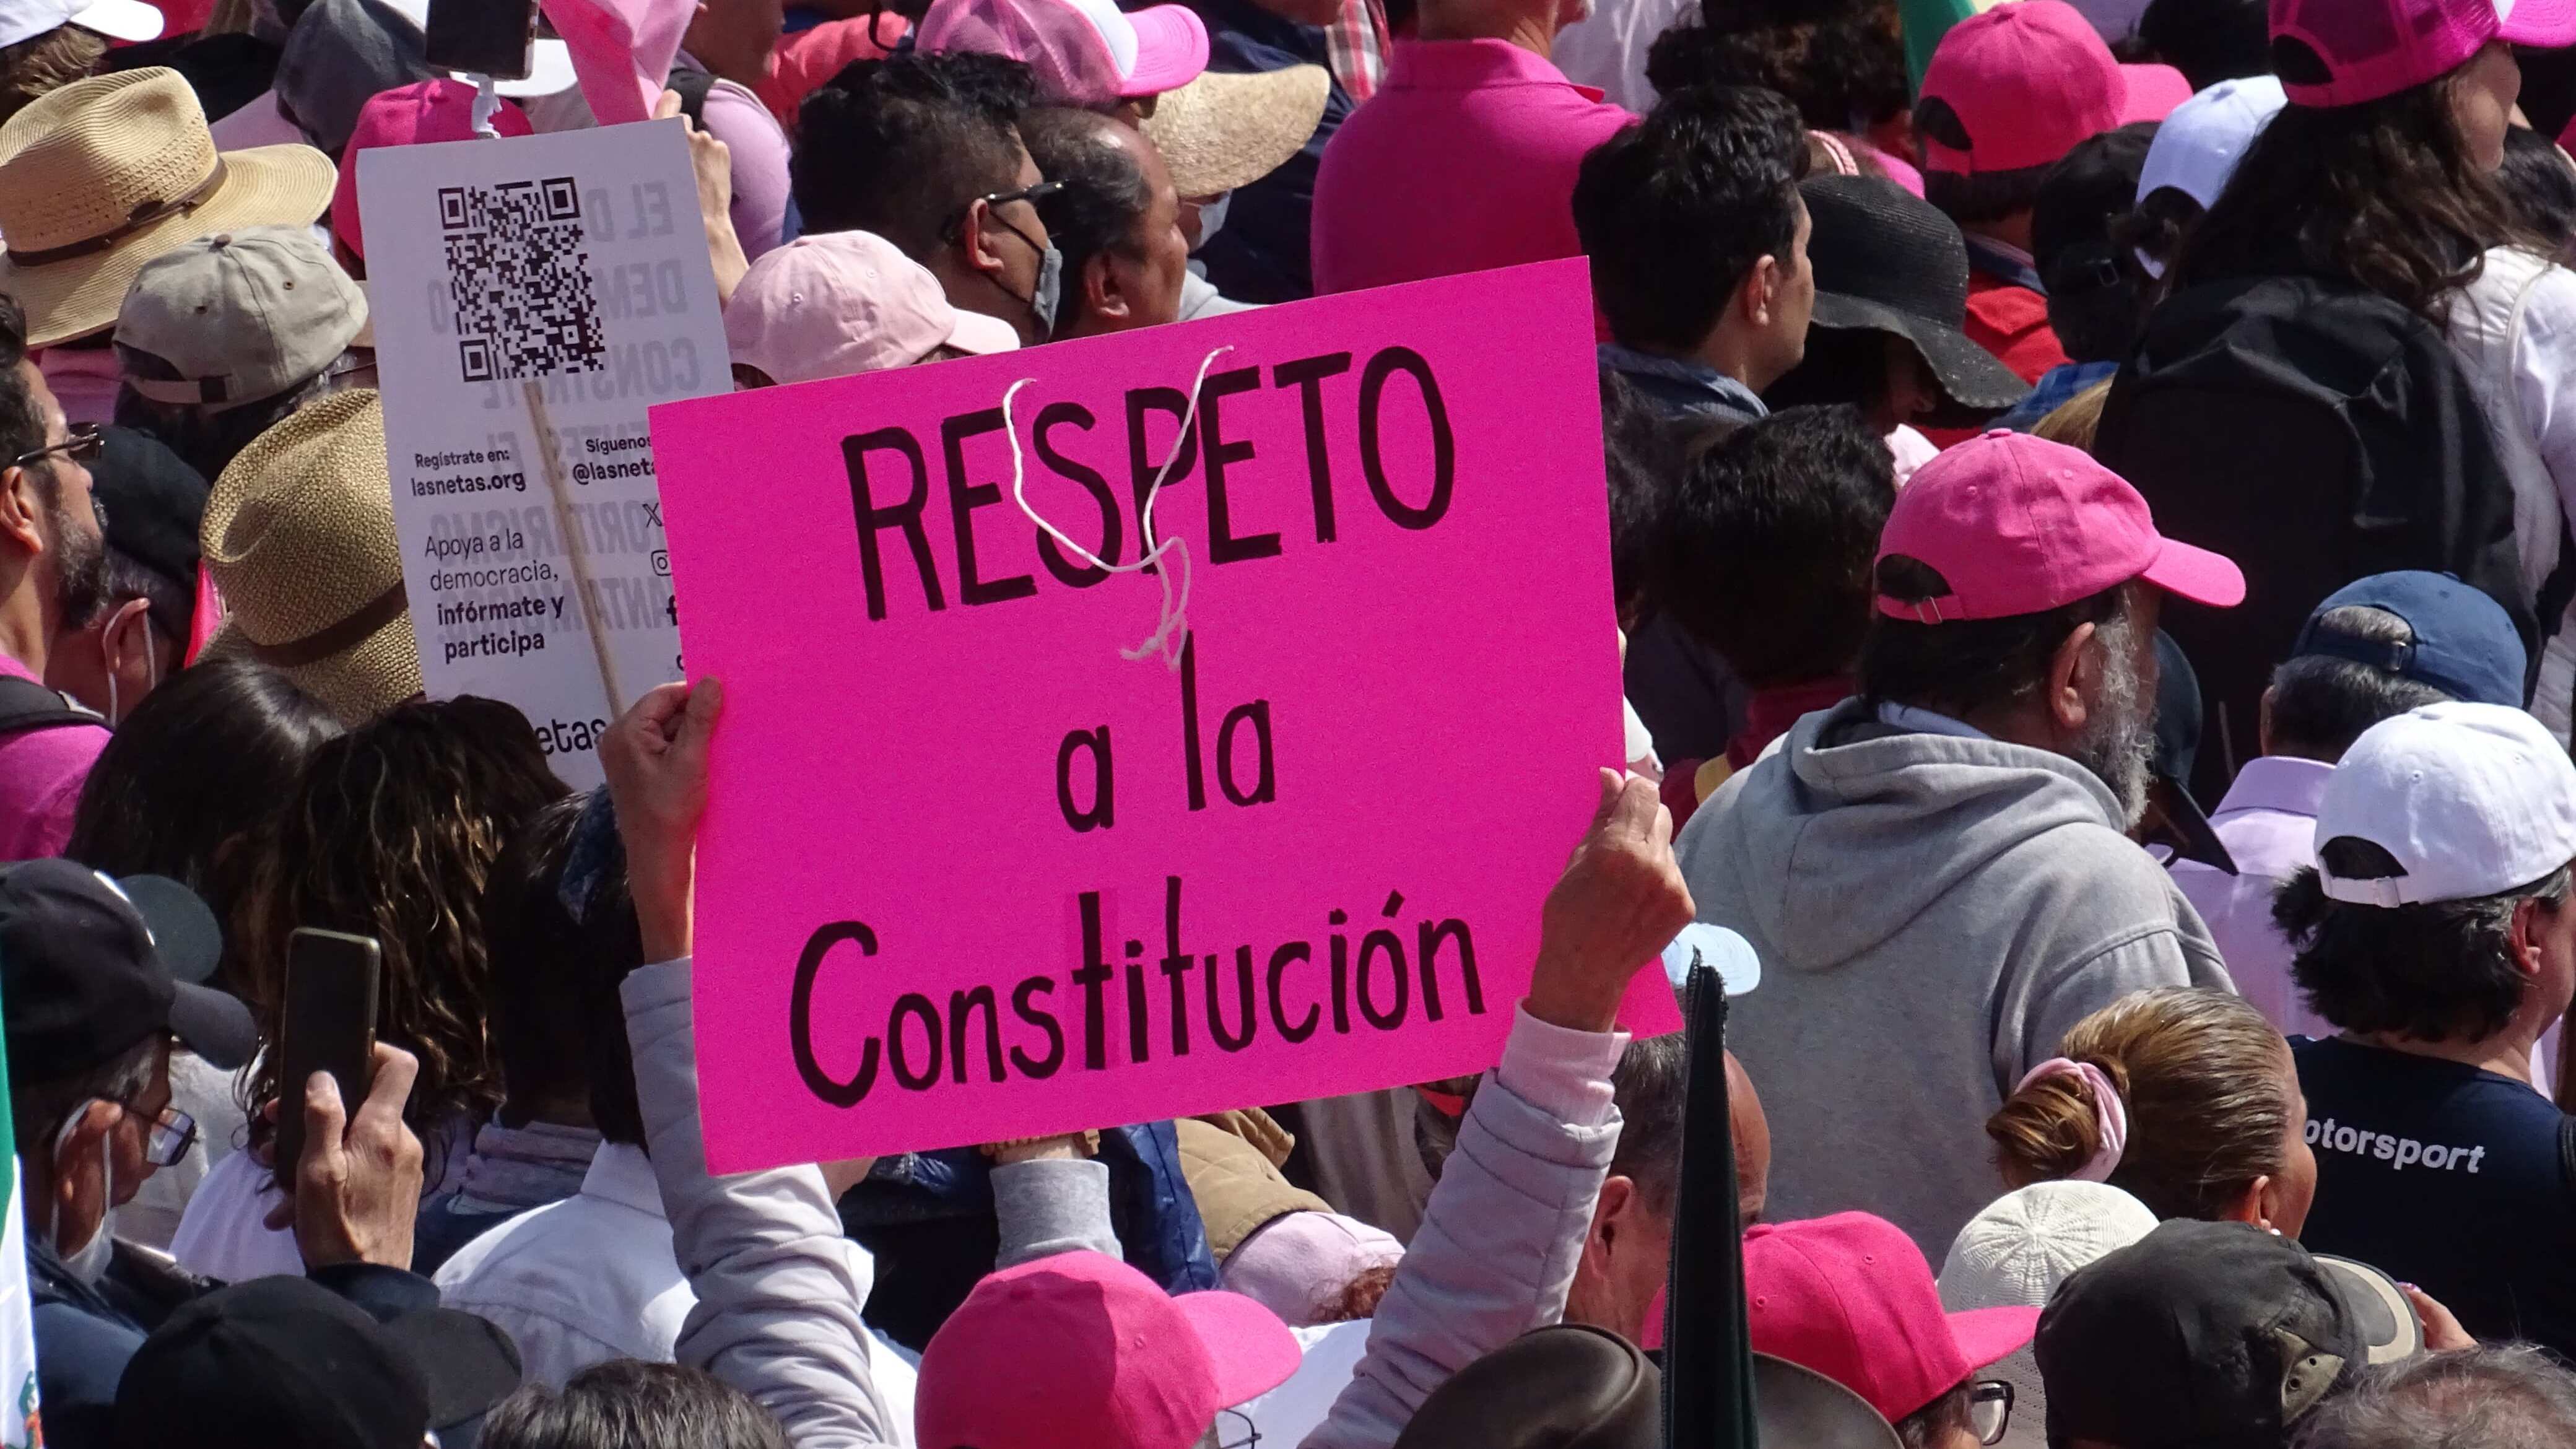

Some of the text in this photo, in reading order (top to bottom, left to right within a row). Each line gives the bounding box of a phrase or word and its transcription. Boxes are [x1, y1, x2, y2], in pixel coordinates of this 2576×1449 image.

[415, 450, 510, 471] Regístrate en:
[572, 457, 656, 485] @lasnet
[411, 471, 526, 497] lasnetas.org
[840, 346, 1455, 622] RESPETO
[425, 528, 524, 562] Apoya a la
[430, 561, 559, 591] democracia,
[437, 595, 565, 625] infórmate y
[445, 629, 545, 665] participa
[1056, 629, 1276, 833] a la
[790, 875, 1486, 1109] Constitución
[2305, 1118, 2486, 1173] otorsport
